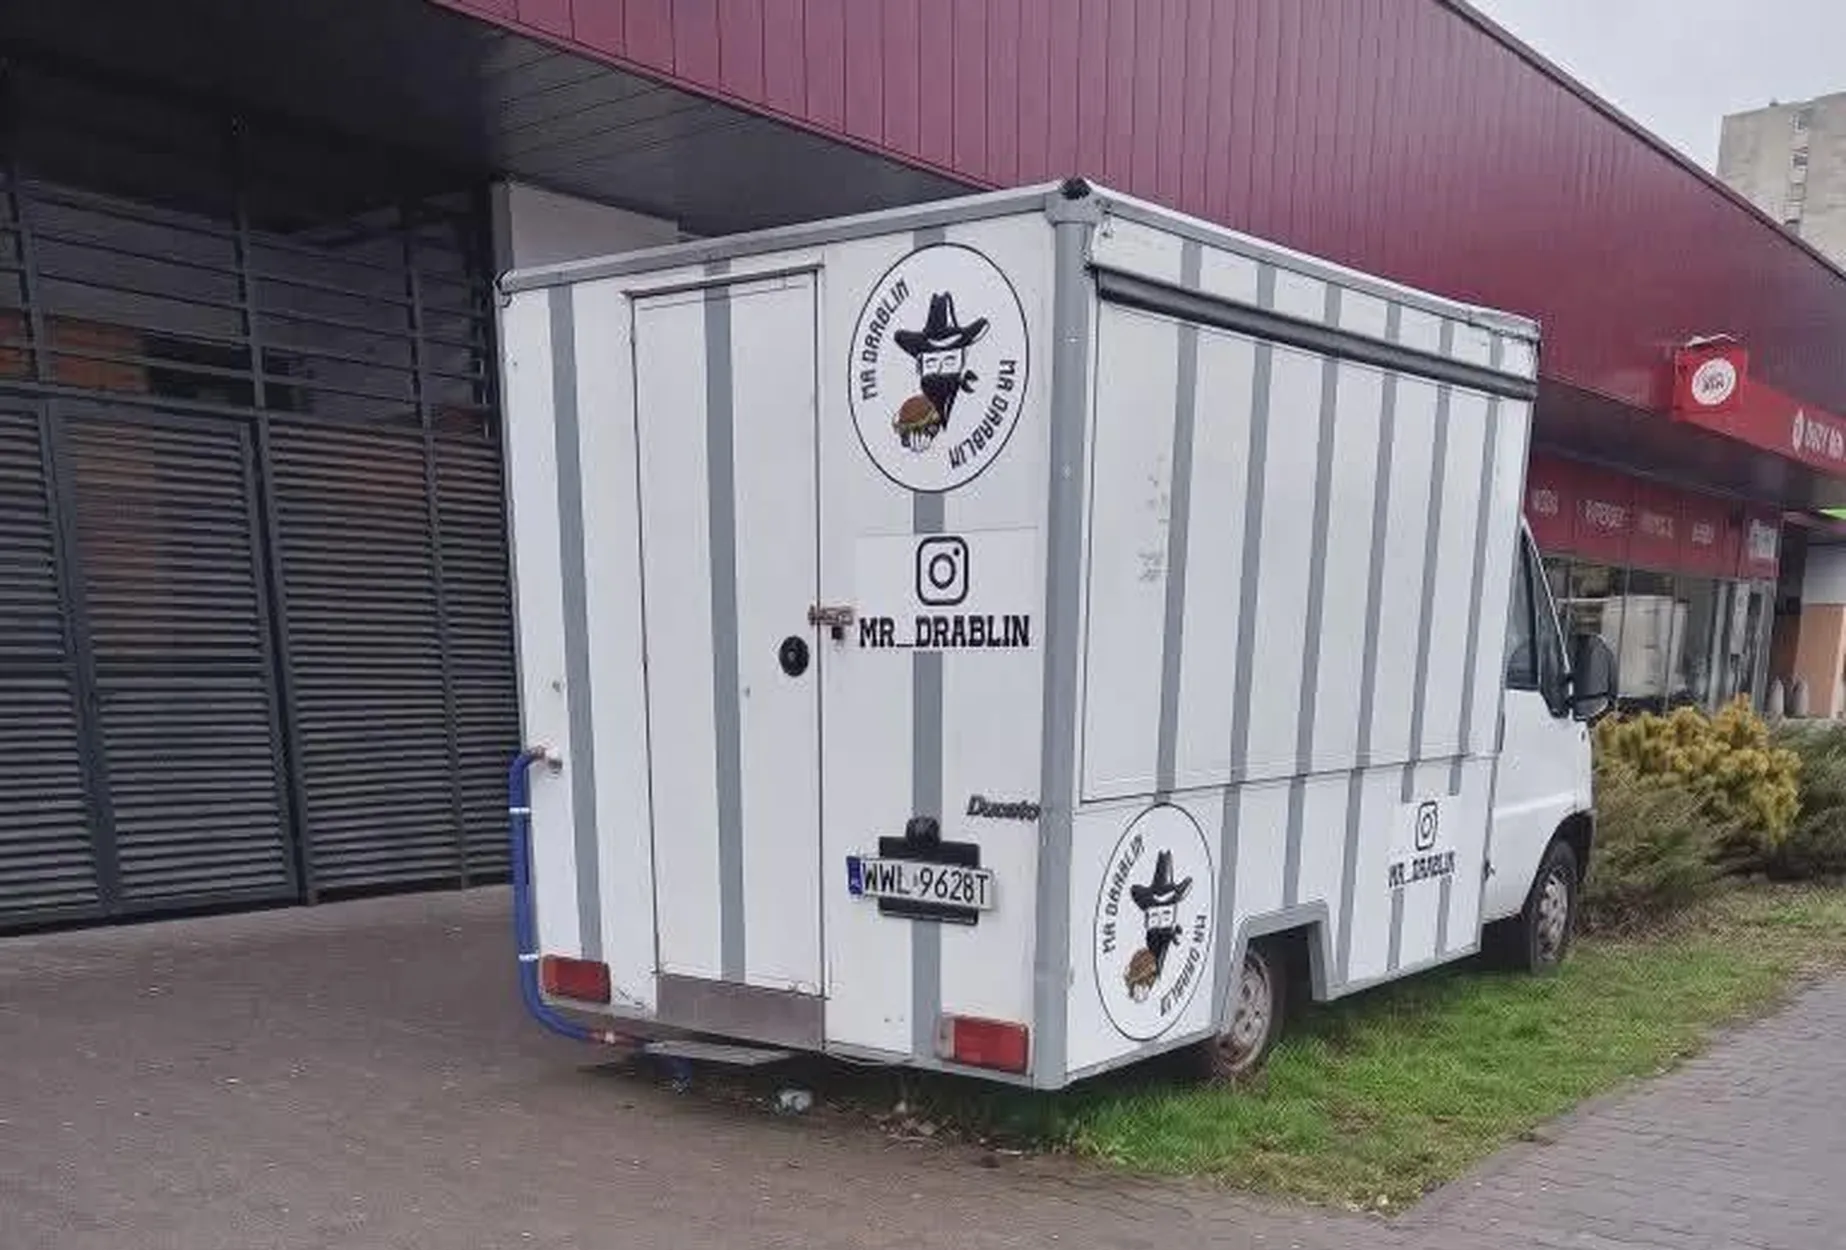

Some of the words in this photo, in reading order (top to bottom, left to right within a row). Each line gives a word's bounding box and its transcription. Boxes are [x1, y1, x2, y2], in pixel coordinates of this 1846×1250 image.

[862, 278, 910, 363] DRABLIN
[860, 369, 877, 401] MR
[996, 359, 1017, 393] MR
[949, 396, 1009, 469] DRABLIN
[859, 615, 1030, 648] MR_DRABLIN
[862, 862, 910, 895] WWL
[919, 867, 989, 905] 9628T
